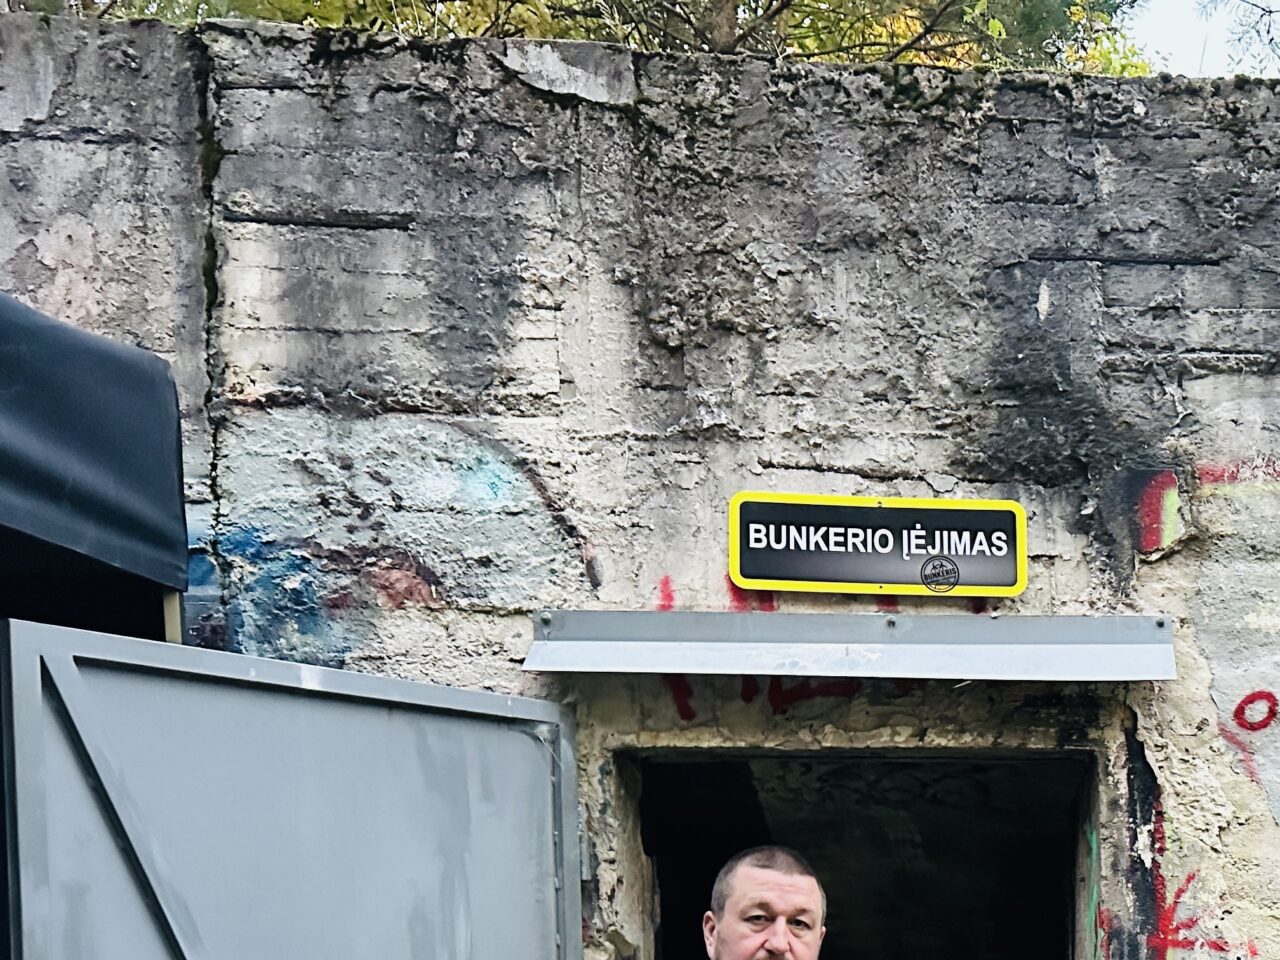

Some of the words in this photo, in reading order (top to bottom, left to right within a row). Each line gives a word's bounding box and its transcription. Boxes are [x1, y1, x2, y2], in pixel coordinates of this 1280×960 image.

[749, 523, 893, 554] BUNKERIO
[902, 524, 1008, 560] ĮĖJIMAS
[924, 566, 956, 583] BUNKERIS
